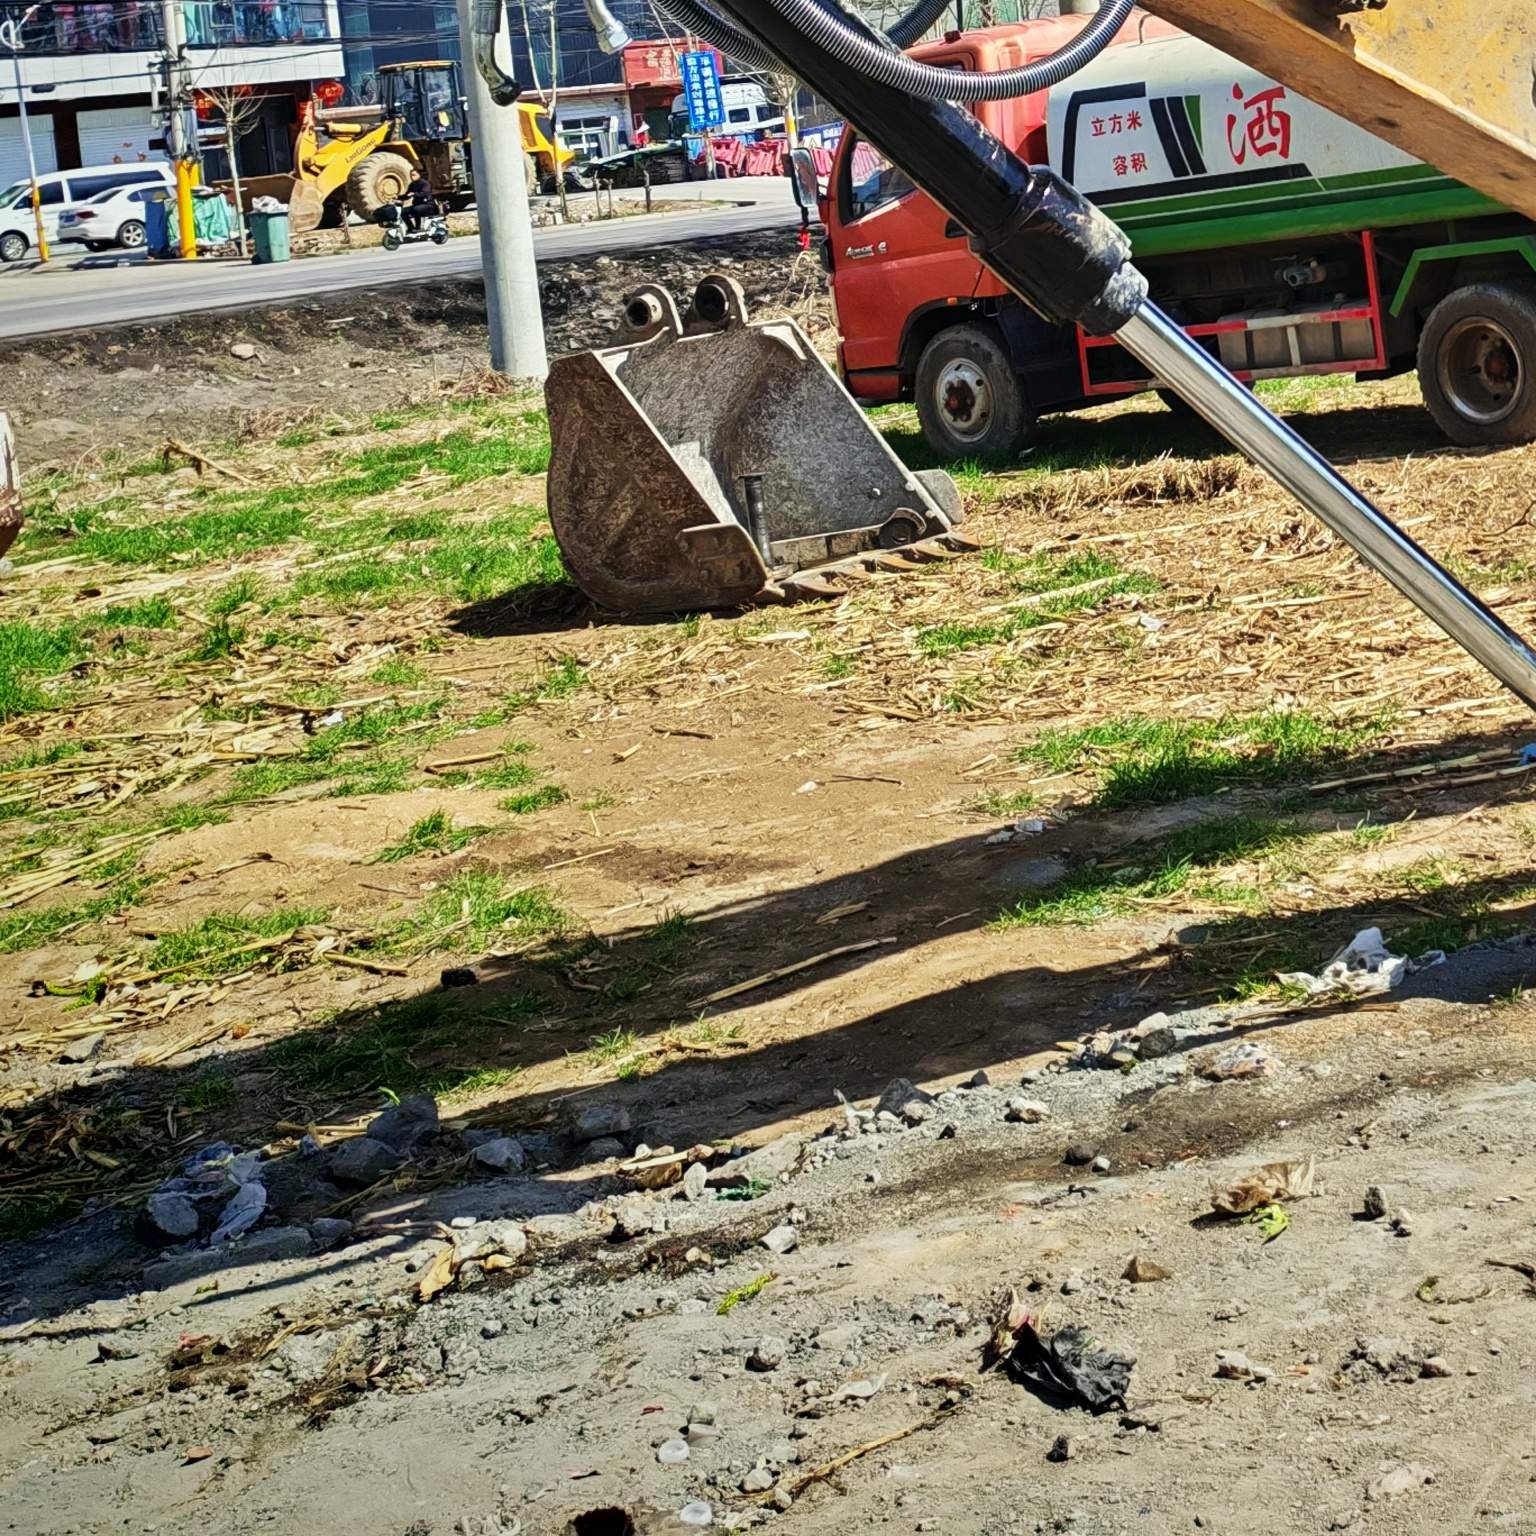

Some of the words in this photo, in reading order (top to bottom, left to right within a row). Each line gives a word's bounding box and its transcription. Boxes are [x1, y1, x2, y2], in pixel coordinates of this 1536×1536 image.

[1090, 109, 1143, 137] 立方米
[1226, 81, 1291, 166] 洒
[1112, 152, 1148, 177] 容积
